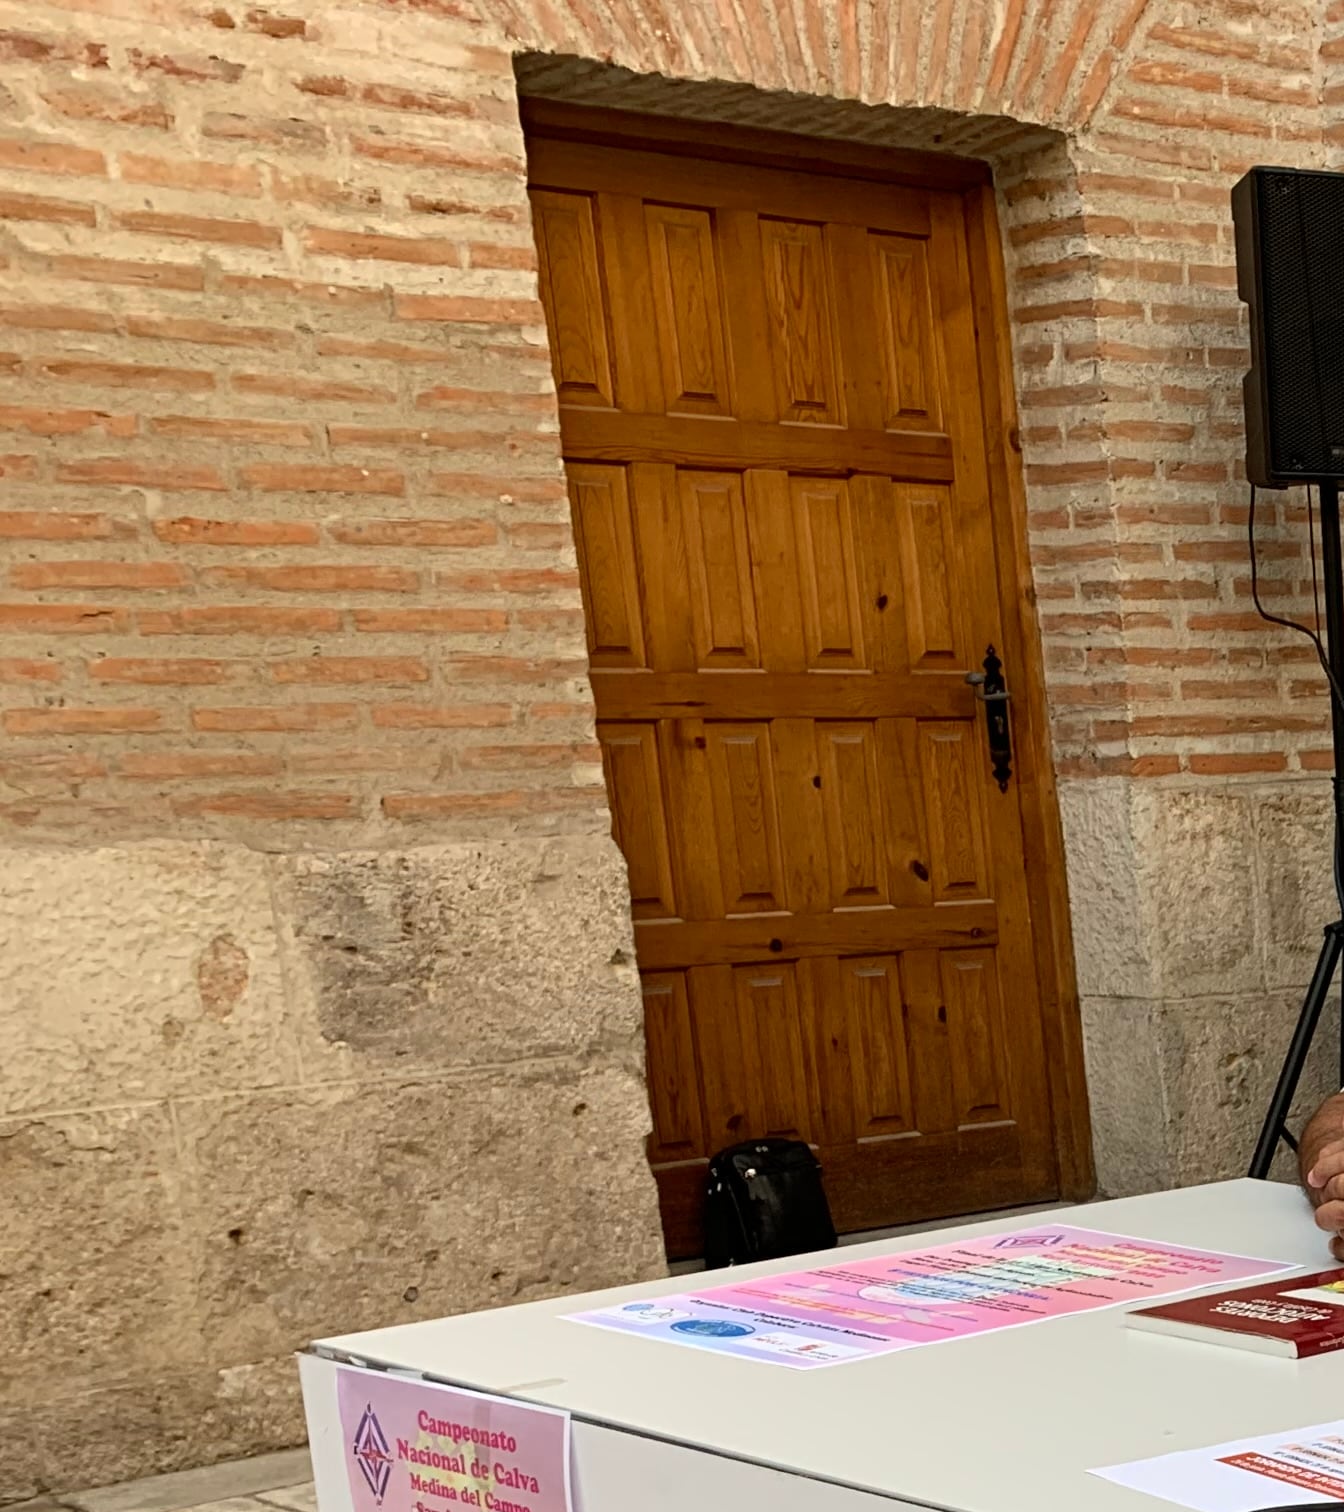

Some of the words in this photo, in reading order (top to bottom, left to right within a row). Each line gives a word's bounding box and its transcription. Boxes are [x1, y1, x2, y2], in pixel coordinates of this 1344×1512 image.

[416, 1410, 517, 1453] Campeonato
[396, 1438, 466, 1475] Nacional
[469, 1456, 489, 1481] de
[492, 1462, 540, 1494] Calva
[409, 1472, 457, 1500] Medina
[459, 1486, 481, 1506] del
